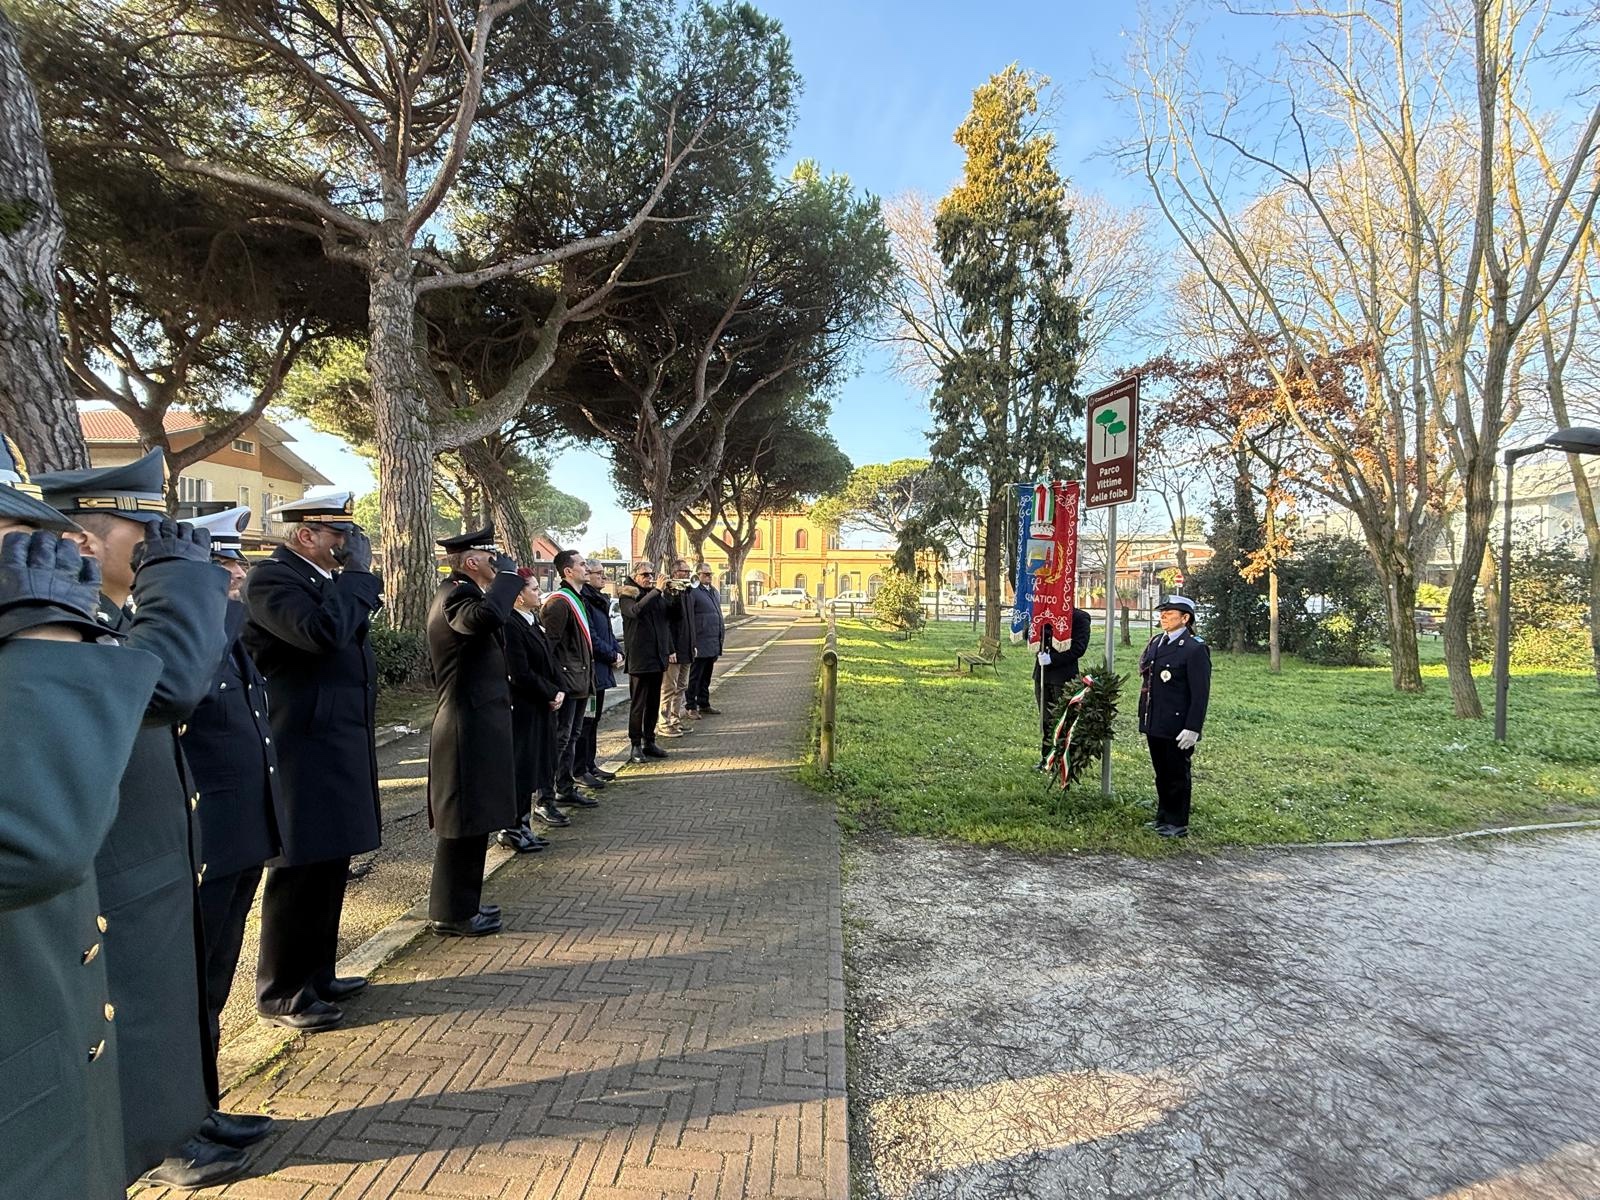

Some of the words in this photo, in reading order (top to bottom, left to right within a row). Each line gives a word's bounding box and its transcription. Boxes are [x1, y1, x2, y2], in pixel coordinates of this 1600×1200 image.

[1099, 465, 1120, 477] Parco
[1096, 477, 1122, 490] Vittime
[1090, 492, 1108, 503] delle
[1109, 488, 1128, 500] foibe
